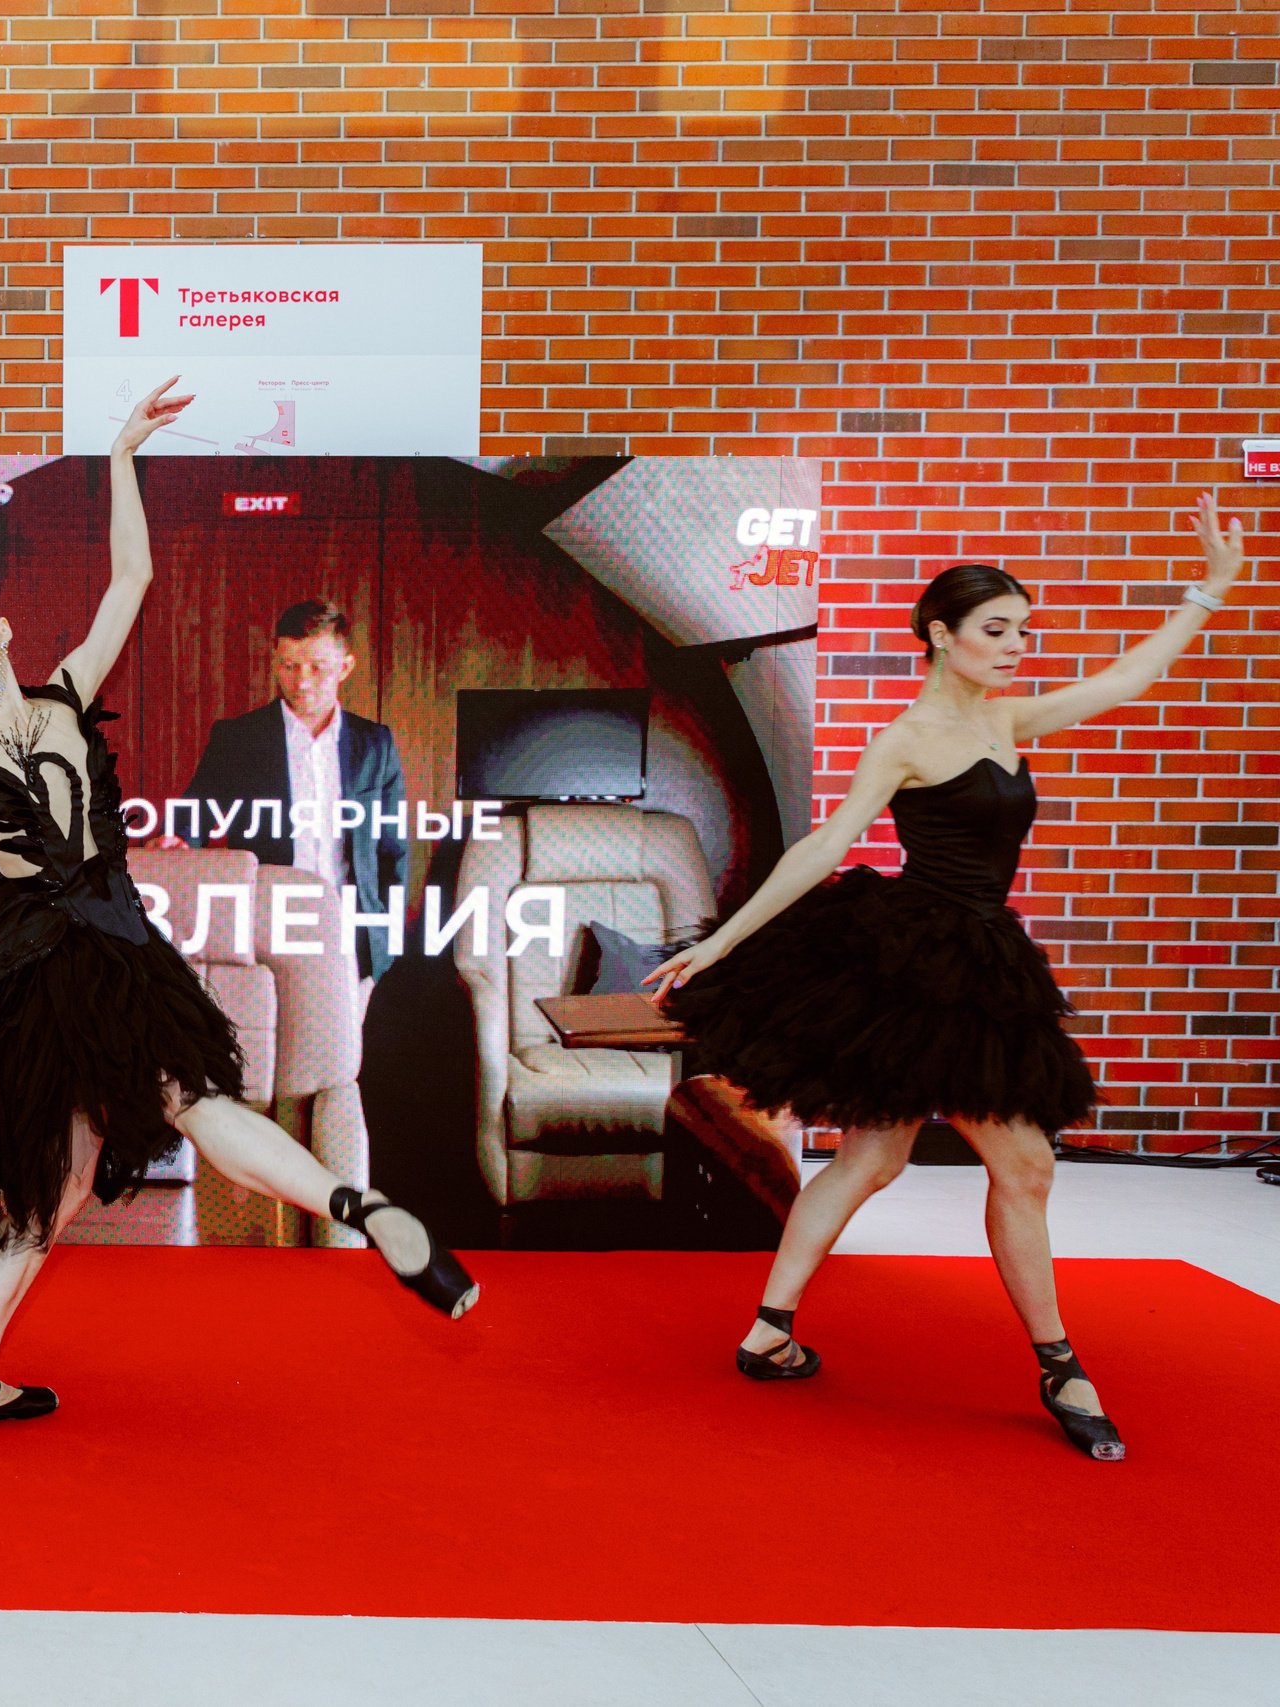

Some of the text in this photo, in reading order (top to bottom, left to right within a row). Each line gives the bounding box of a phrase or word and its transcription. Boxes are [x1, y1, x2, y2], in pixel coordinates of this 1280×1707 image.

[178, 287, 339, 307] Третьяковская
[179, 314, 266, 331] галерея
[115, 379, 132, 403] 4
[1248, 463, 1280, 472] НЕ В
[234, 496, 289, 512] EXIT
[736, 507, 817, 546] GET
[748, 549, 819, 587] JET
[118, 797, 503, 841] ОПУЛЯРНЫЕ
